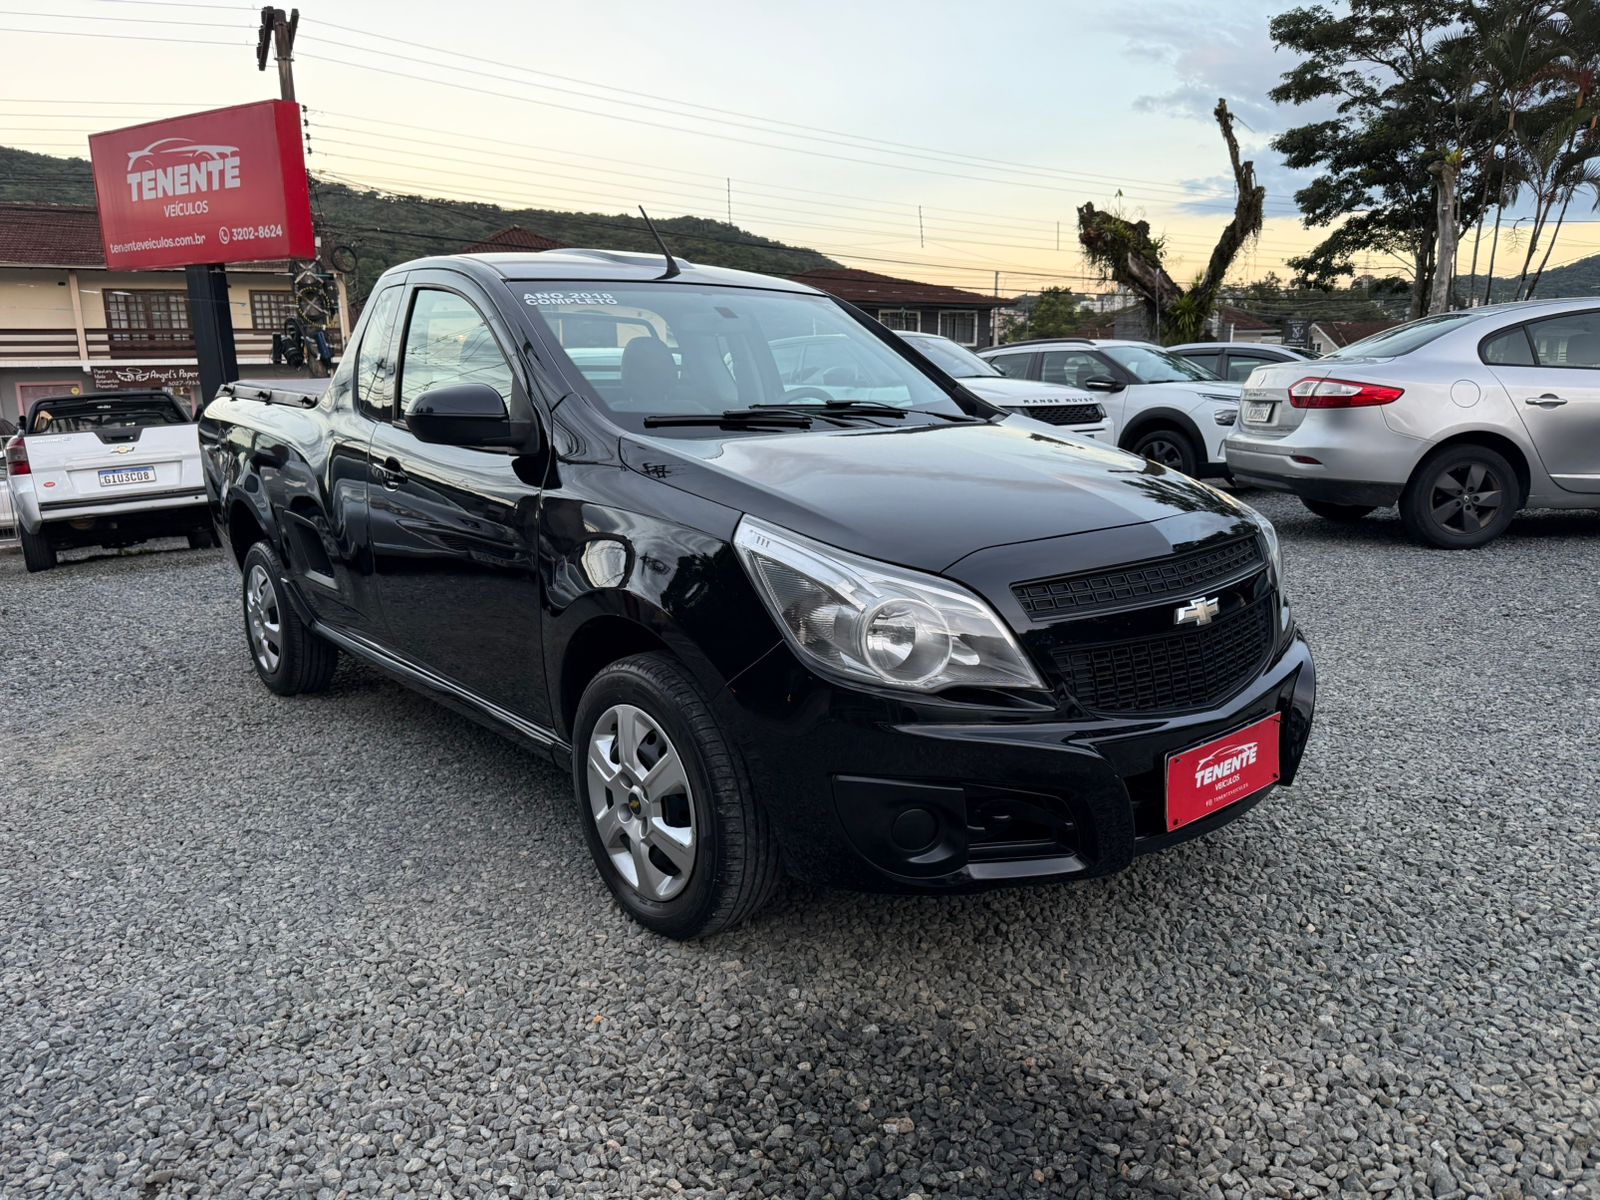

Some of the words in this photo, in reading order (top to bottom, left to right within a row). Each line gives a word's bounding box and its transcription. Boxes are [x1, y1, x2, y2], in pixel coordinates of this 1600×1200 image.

[126, 156, 241, 202] TENENTE
[164, 200, 209, 218] VEÍCULOS
[110, 233, 206, 254] tenenteveiculos.com.br
[231, 224, 283, 241] 3202-8624
[523, 292, 564, 300] ANO
[525, 298, 618, 306] COMPLETO
[149, 368, 177, 383] Angel's
[178, 368, 199, 380] Paper
[104, 471, 150, 484] GIU3C08
[1195, 746, 1258, 789] TENENTE
